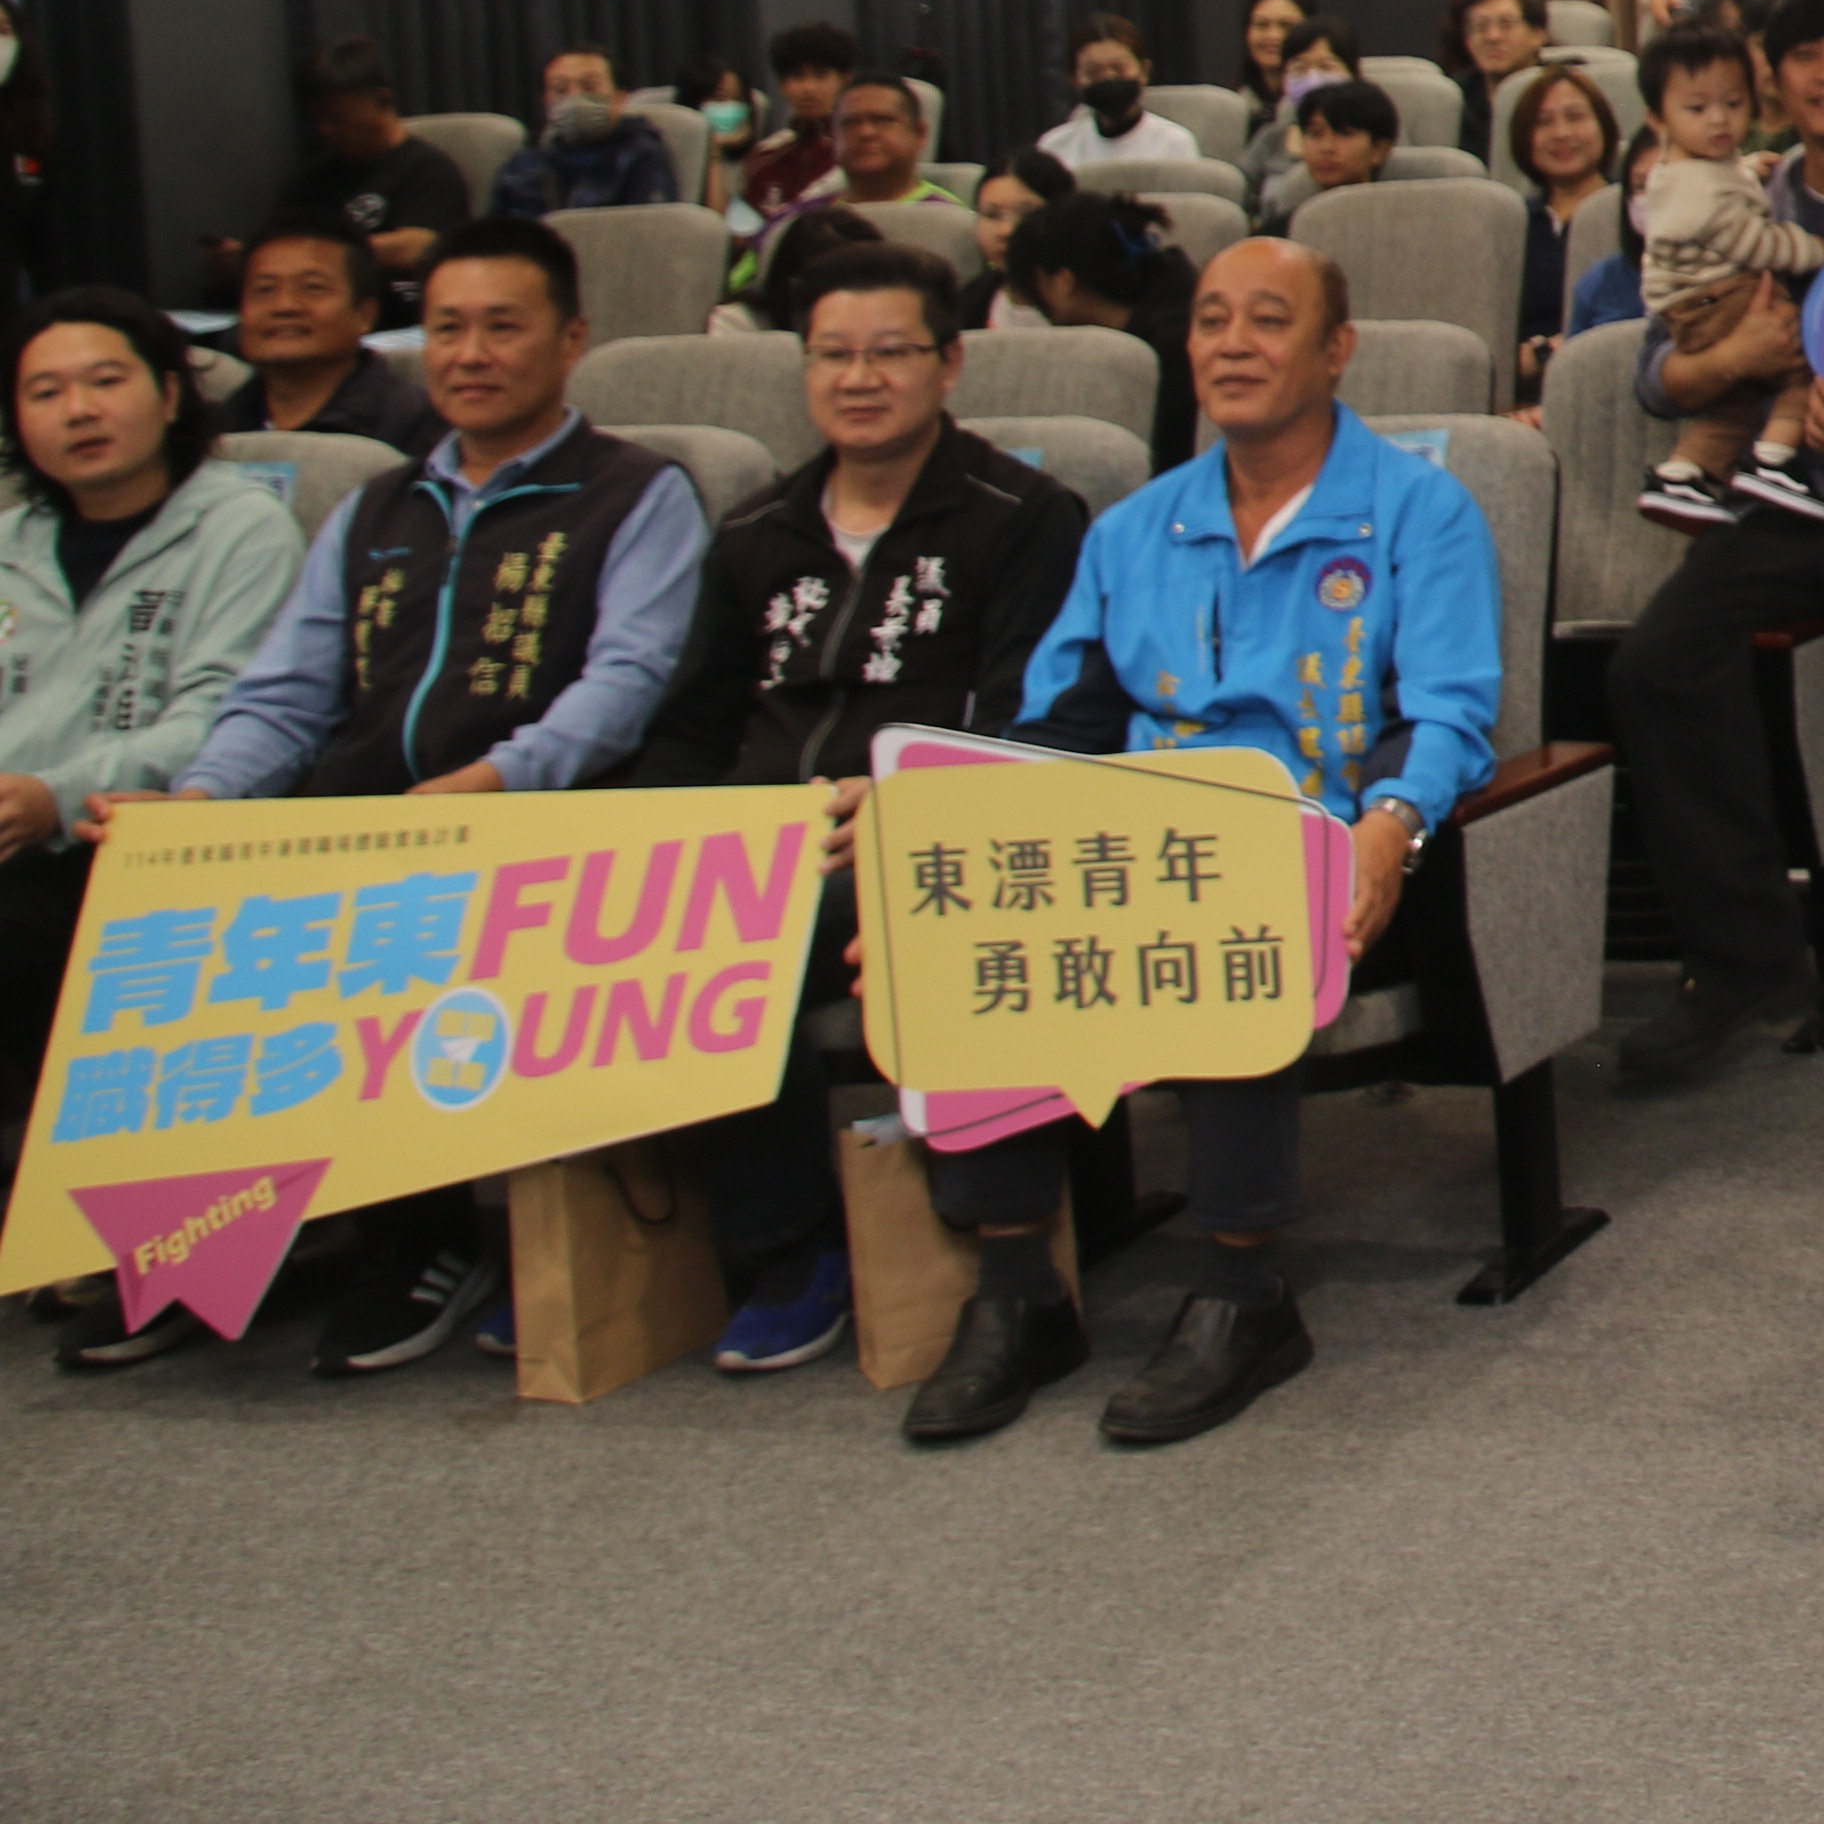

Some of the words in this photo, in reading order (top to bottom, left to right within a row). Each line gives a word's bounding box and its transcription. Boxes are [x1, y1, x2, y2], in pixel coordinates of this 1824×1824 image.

[909, 826, 1222, 917] 東漂青年
[972, 925, 1284, 1014] 勇敢向前
[134, 1175, 276, 1276] Fighting
